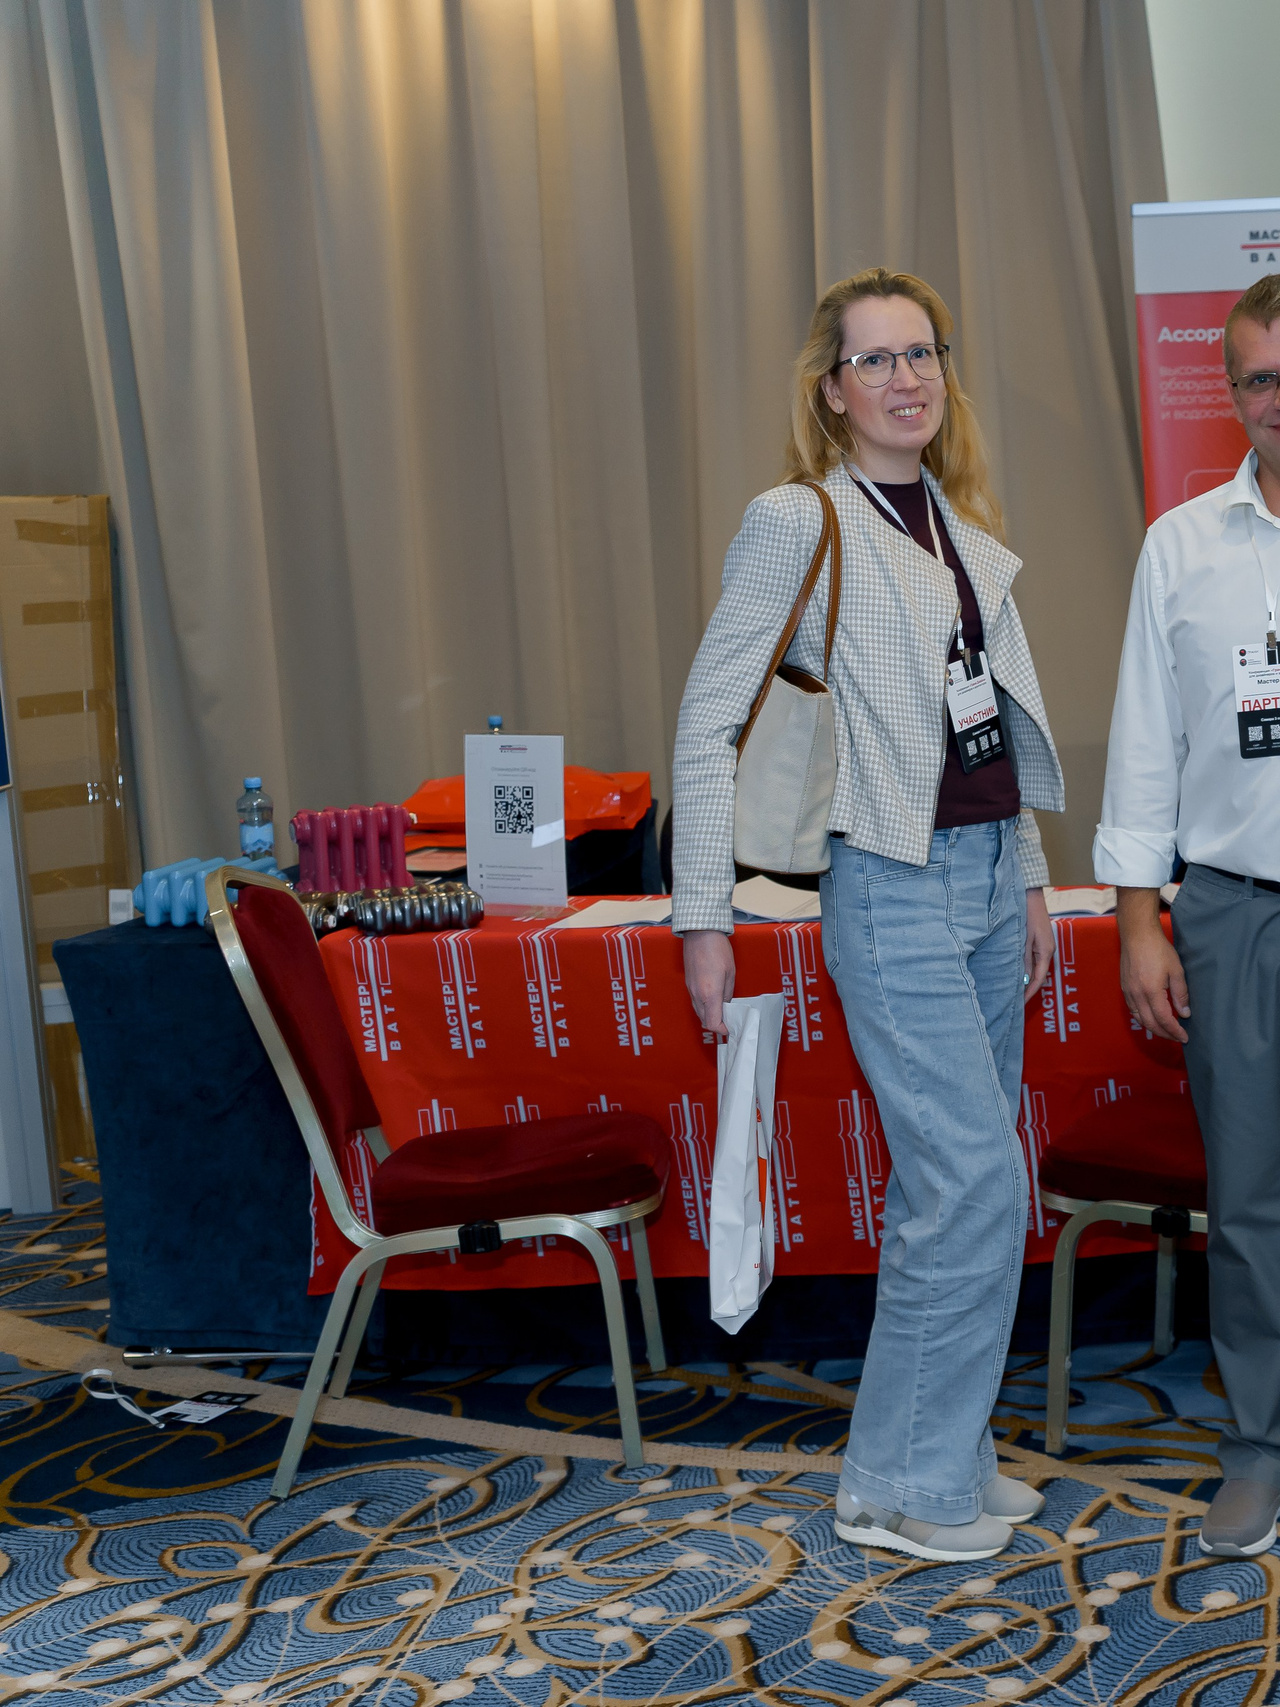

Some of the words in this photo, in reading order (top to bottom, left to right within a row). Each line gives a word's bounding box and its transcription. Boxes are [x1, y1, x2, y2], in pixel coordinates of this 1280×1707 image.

[957, 705, 997, 729] УЧАСТНИК
[357, 985, 378, 1053] МАСТЕР
[381, 986, 402, 1051] ВАТТ
[442, 984, 463, 1050] МАСТЕР
[466, 985, 487, 1049] ВАТТ
[526, 982, 547, 1048] МАСТЕР
[550, 983, 570, 1047] ВАТТ
[611, 980, 631, 1047] МАСТЕР
[634, 981, 654, 1046] ВАТТ
[781, 976, 800, 1042] МАСТЕР
[805, 976, 823, 1041] ВАТТ
[1064, 966, 1081, 1033] ВАТТ
[681, 1179, 701, 1241] МАСТЕР
[786, 1179, 804, 1243] ВАТТ
[847, 1178, 866, 1240] МАСТЕР
